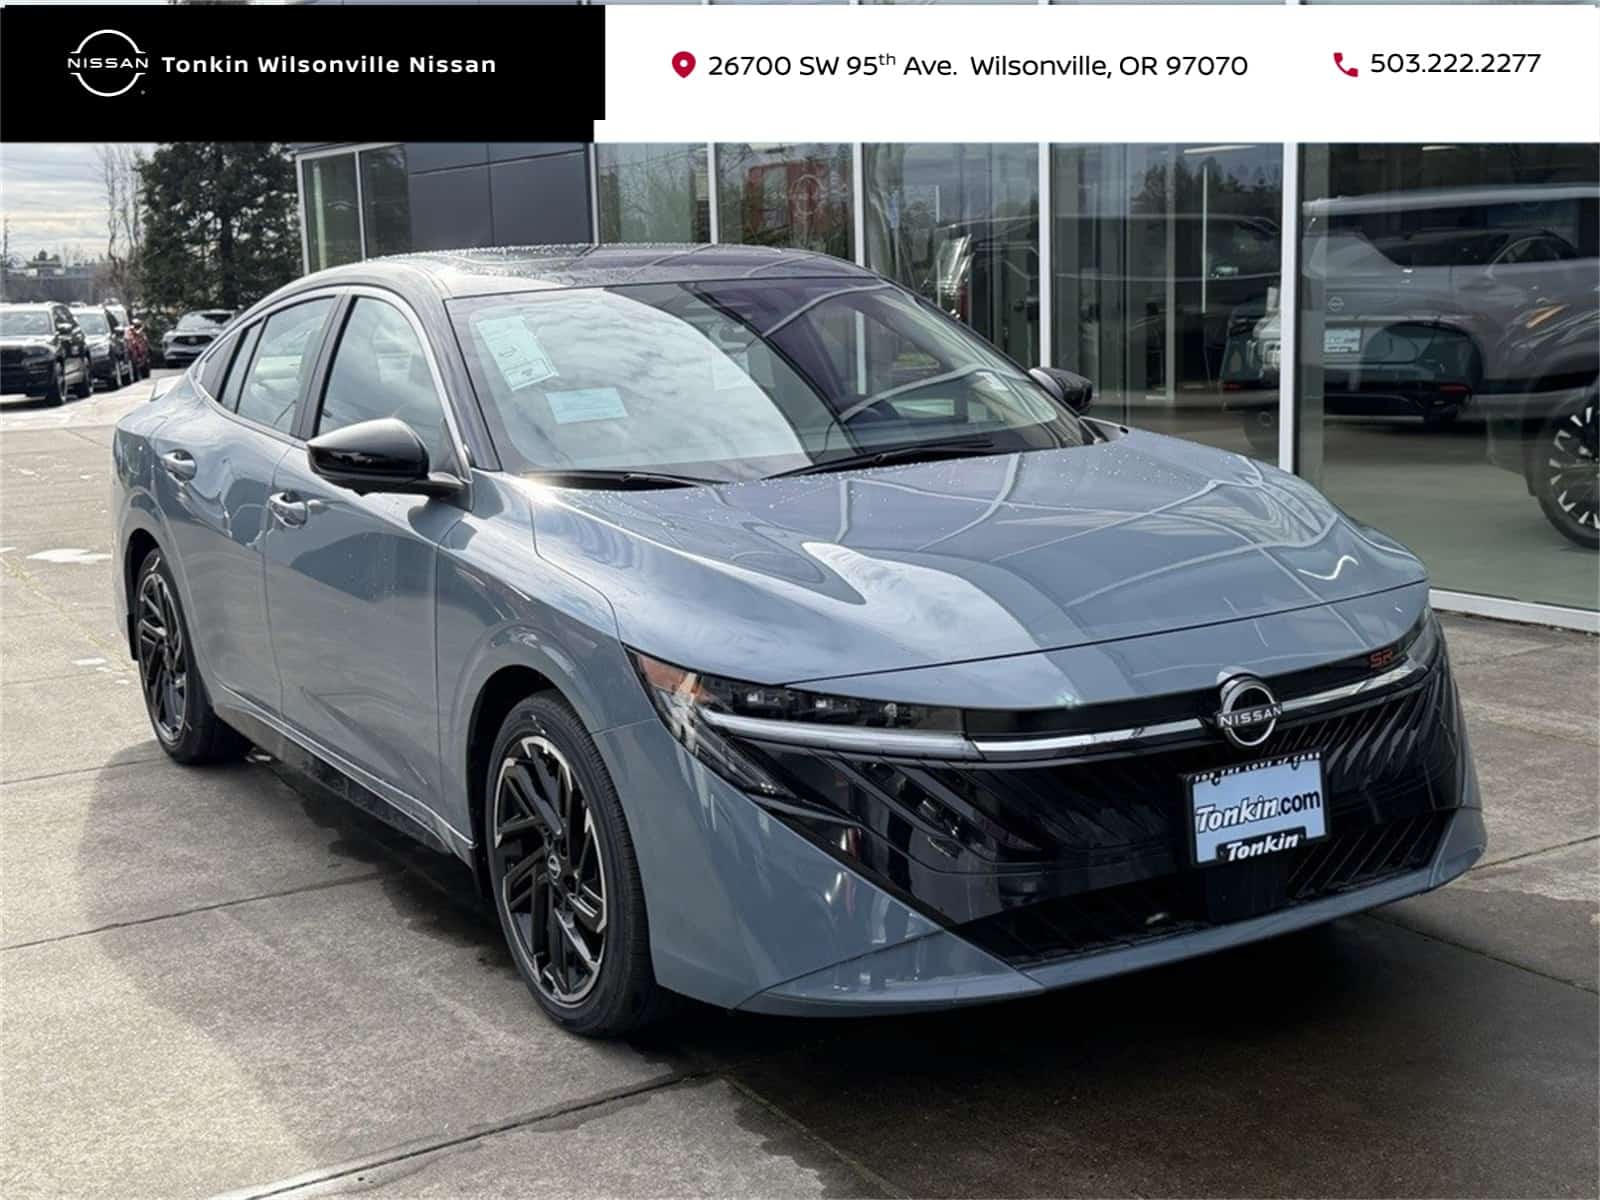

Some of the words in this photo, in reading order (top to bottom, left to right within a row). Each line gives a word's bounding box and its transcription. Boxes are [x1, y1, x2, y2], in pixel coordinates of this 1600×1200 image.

[1369, 648, 1393, 669] SR
[1219, 706, 1281, 727] NISSAN
[1194, 790, 1321, 833] Tonkin.com
[1226, 833, 1299, 861] Tonkin
